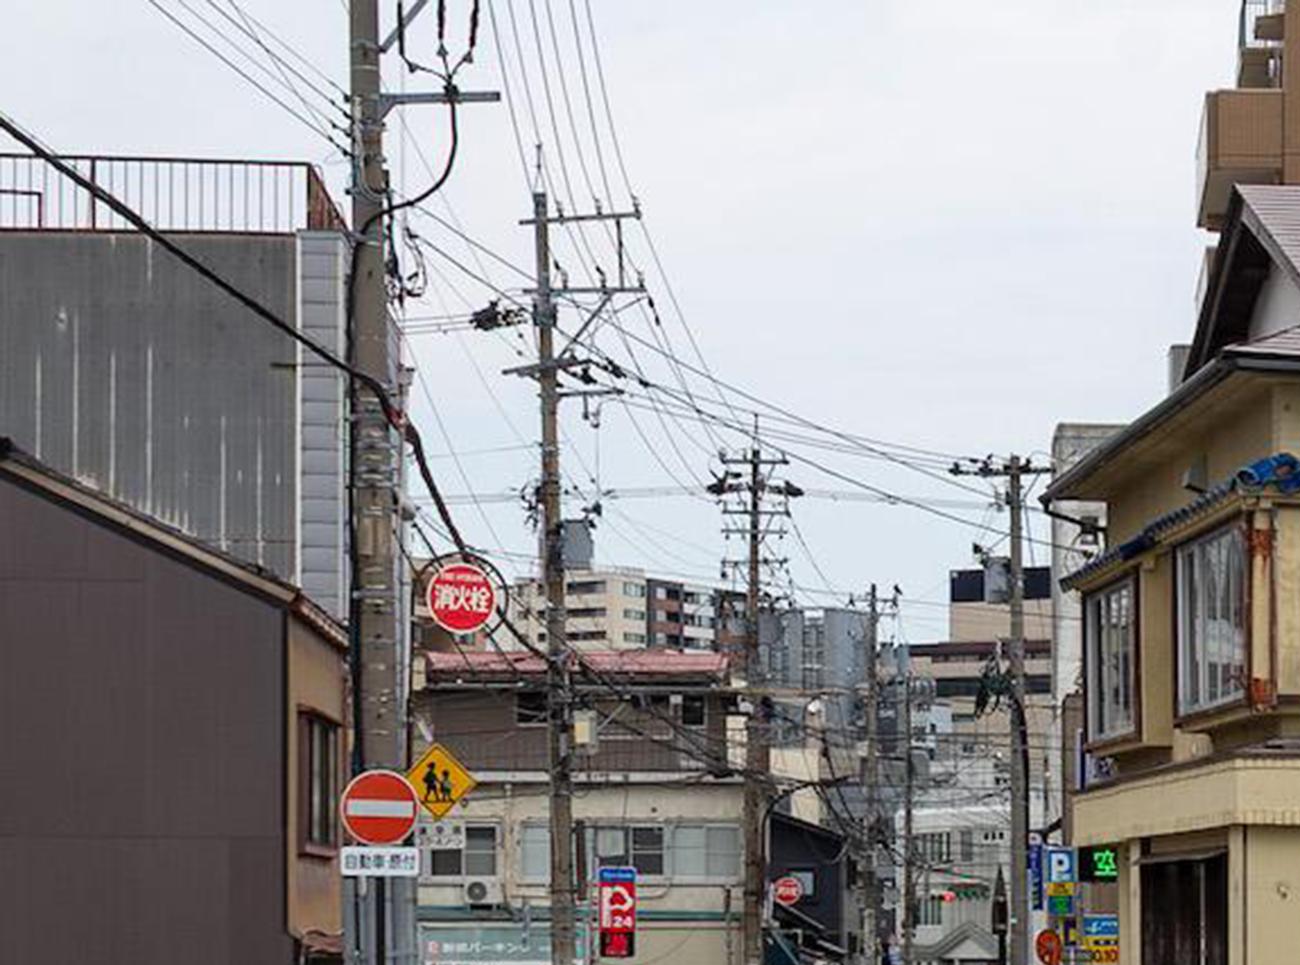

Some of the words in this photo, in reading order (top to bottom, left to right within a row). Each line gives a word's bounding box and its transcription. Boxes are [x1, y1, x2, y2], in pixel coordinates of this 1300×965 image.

[434, 584, 492, 613] 消火栓
[1050, 852, 1071, 882] P
[602, 886, 634, 929] P
[613, 916, 633, 928] 24
